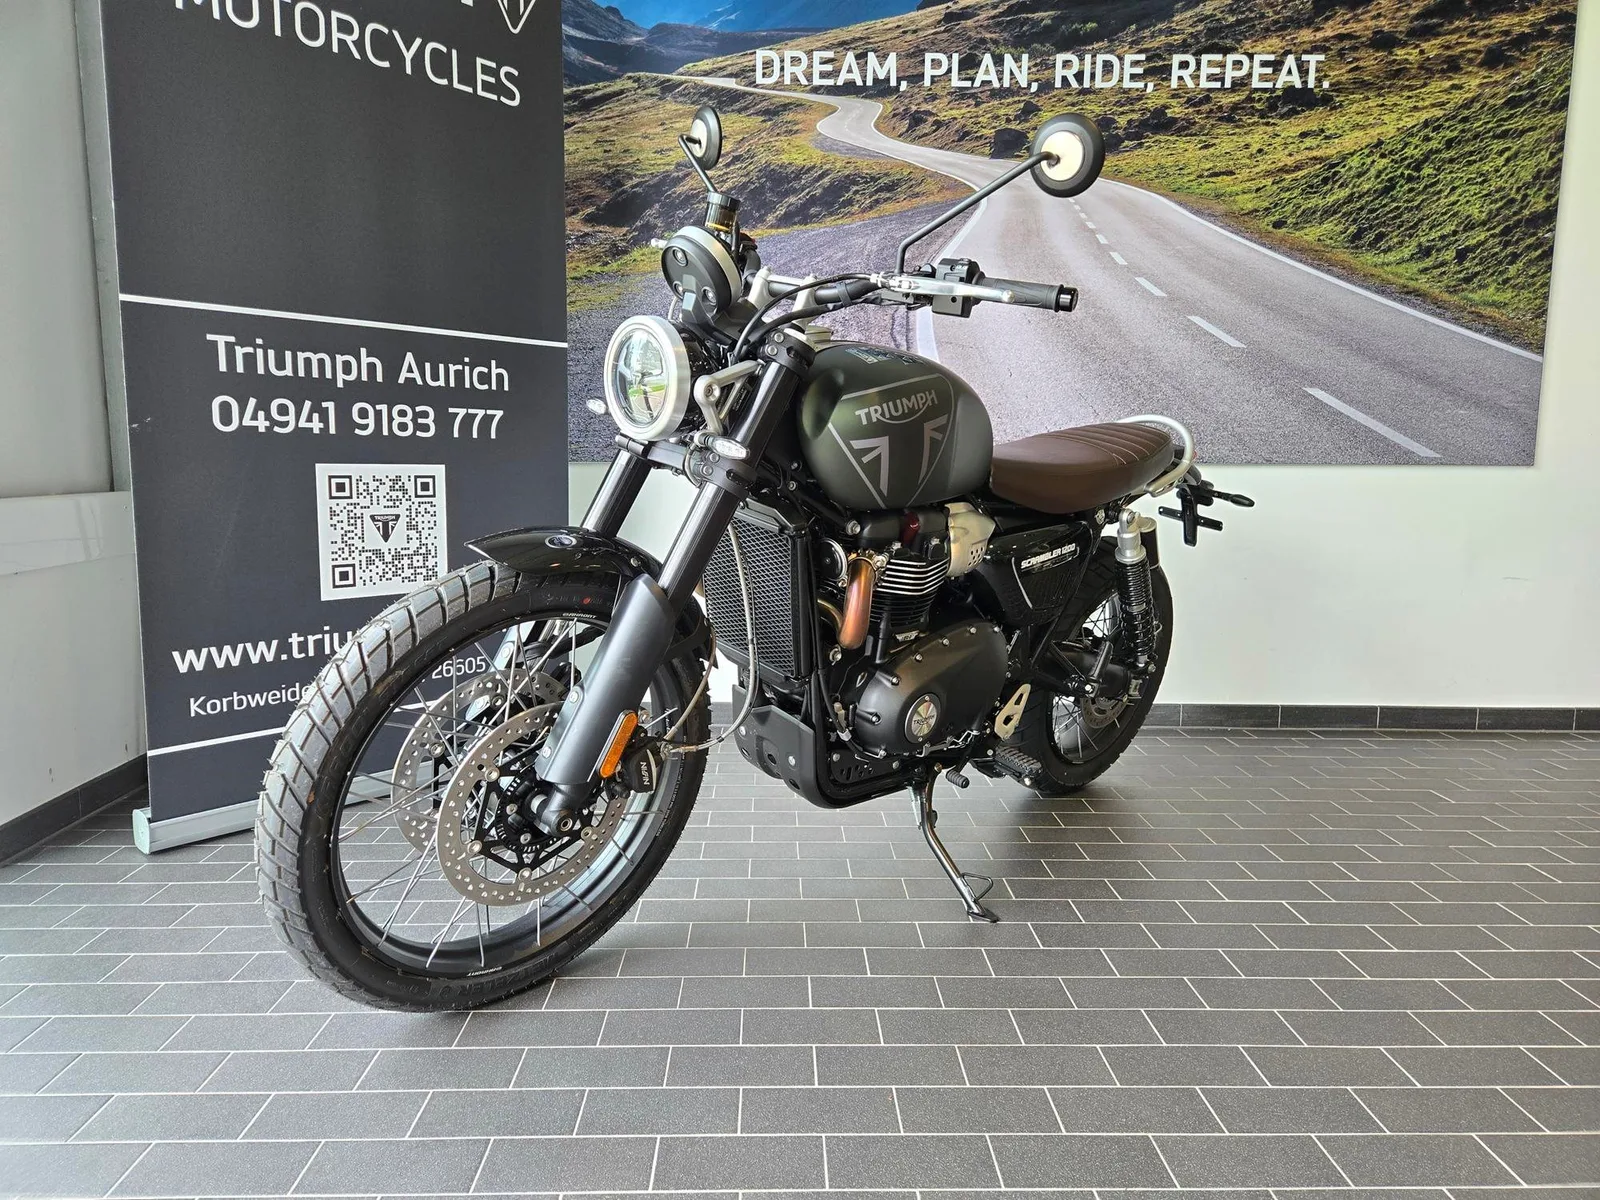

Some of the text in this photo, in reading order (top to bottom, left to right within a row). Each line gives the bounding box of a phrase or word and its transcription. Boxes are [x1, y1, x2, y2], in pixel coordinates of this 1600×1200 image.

[754, 49, 1331, 94] DREAM, PLAN, RIDE, REPEAT.
[206, 333, 510, 392] Triumph Aurich
[211, 395, 504, 440] 04941 9183 777
[854, 389, 938, 426] TRIUMPH
